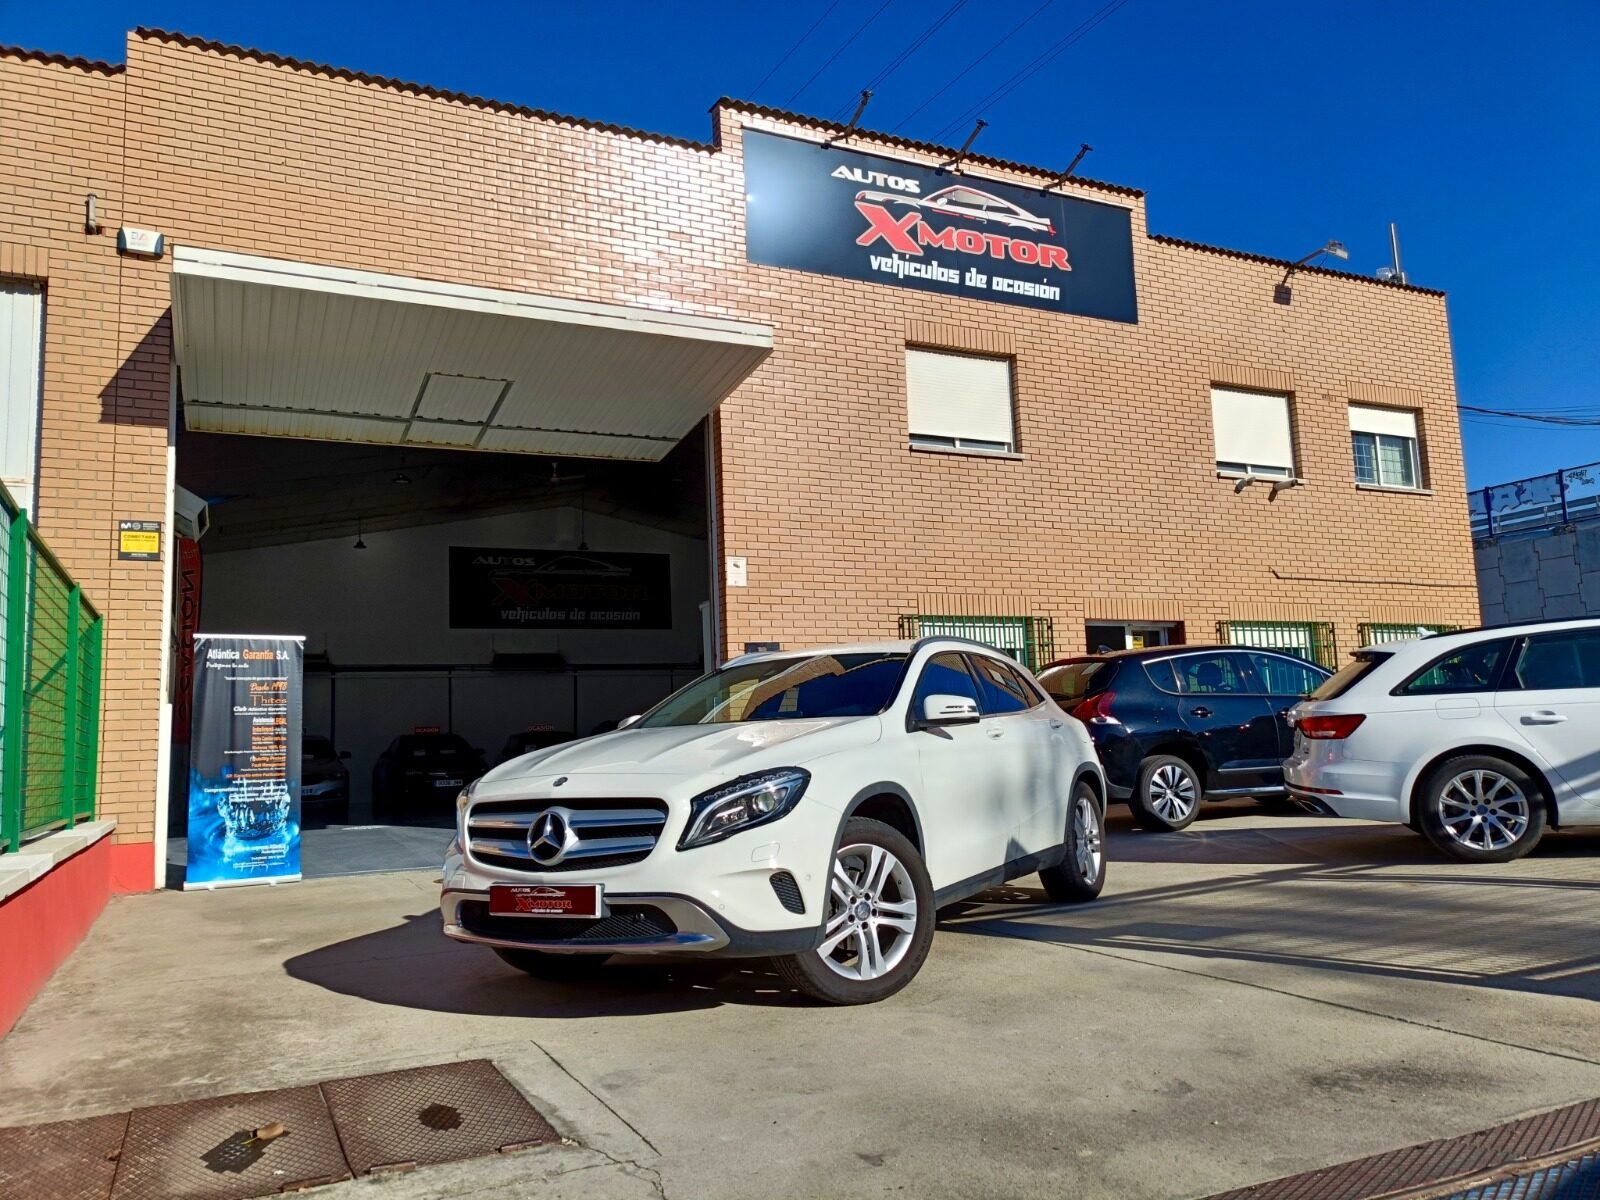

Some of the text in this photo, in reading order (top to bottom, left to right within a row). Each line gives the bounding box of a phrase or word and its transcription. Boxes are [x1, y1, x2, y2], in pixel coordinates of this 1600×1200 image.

[831, 164, 921, 194] AUTOS
[964, 267, 988, 290] de
[991, 277, 1060, 302] ocasión
[472, 555, 536, 566] AUTOS
[569, 608, 585, 621] de
[206, 648, 240, 660] Atlántica
[242, 648, 274, 660] Garantía
